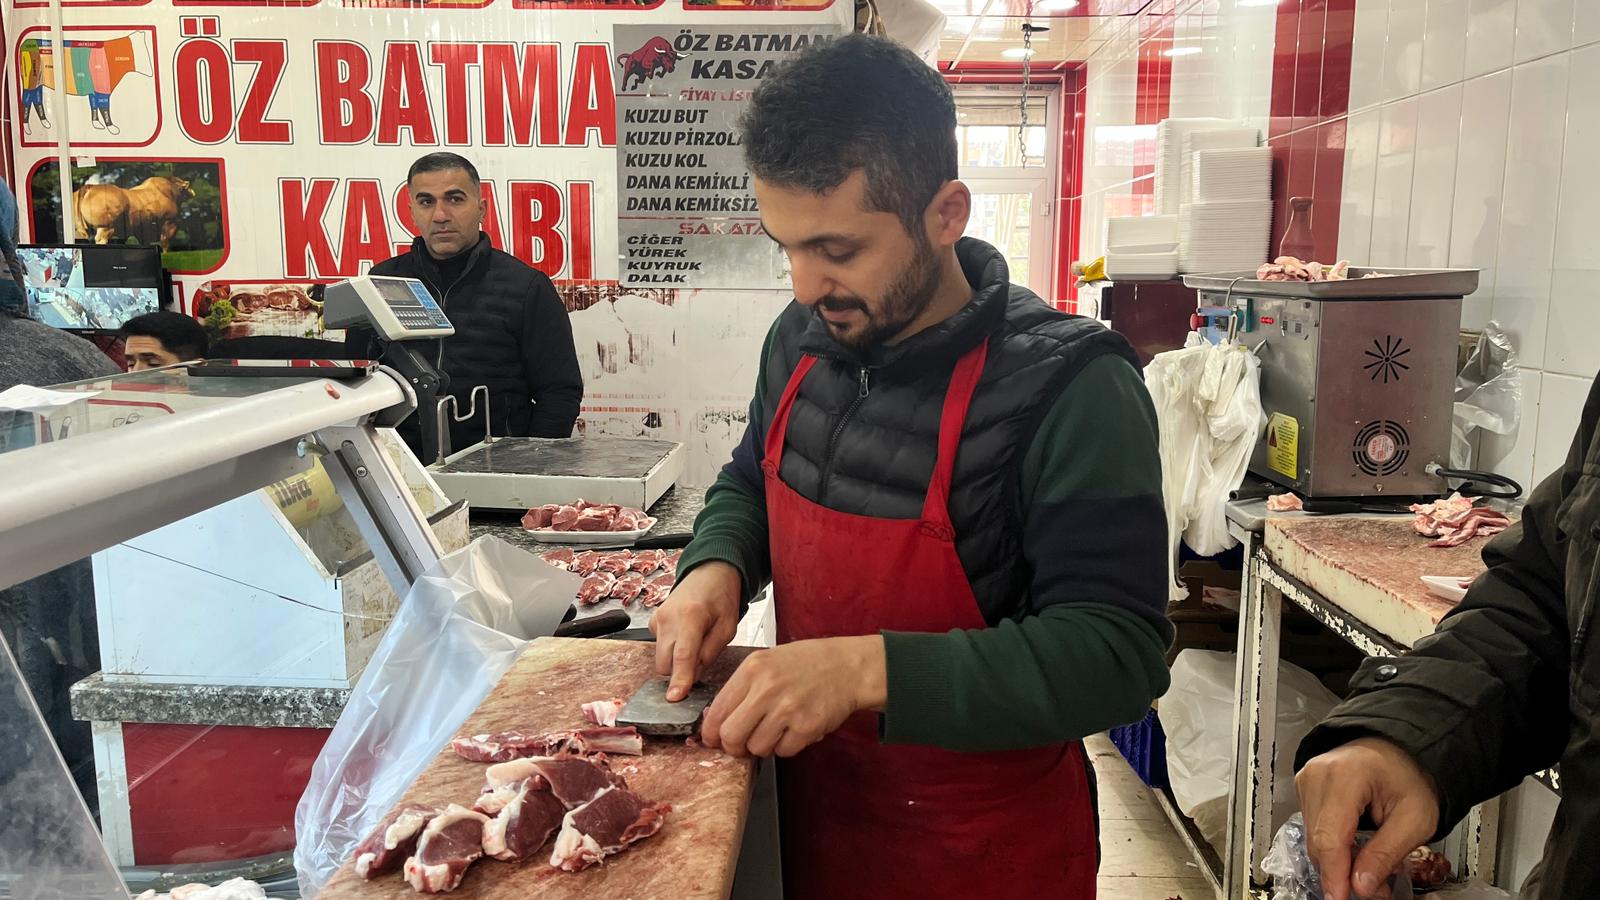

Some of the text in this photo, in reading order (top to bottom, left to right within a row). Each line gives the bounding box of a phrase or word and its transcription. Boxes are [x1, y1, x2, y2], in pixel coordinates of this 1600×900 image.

[674, 29, 711, 52] ÖZ
[172, 15, 294, 146] ÖZ
[625, 109, 708, 124] KUZU BUT
[625, 132, 672, 146] KUZU
[625, 154, 708, 168] KUZU KOL
[627, 172, 749, 190] DANA KEMİKLİ
[627, 194, 759, 211] DANA KEMİKSİZ
[627, 234, 683, 245] CİĞER
[628, 247, 687, 258] YÜREK
[628, 261, 702, 271] KUYRUK
[628, 274, 687, 283] DALAK
